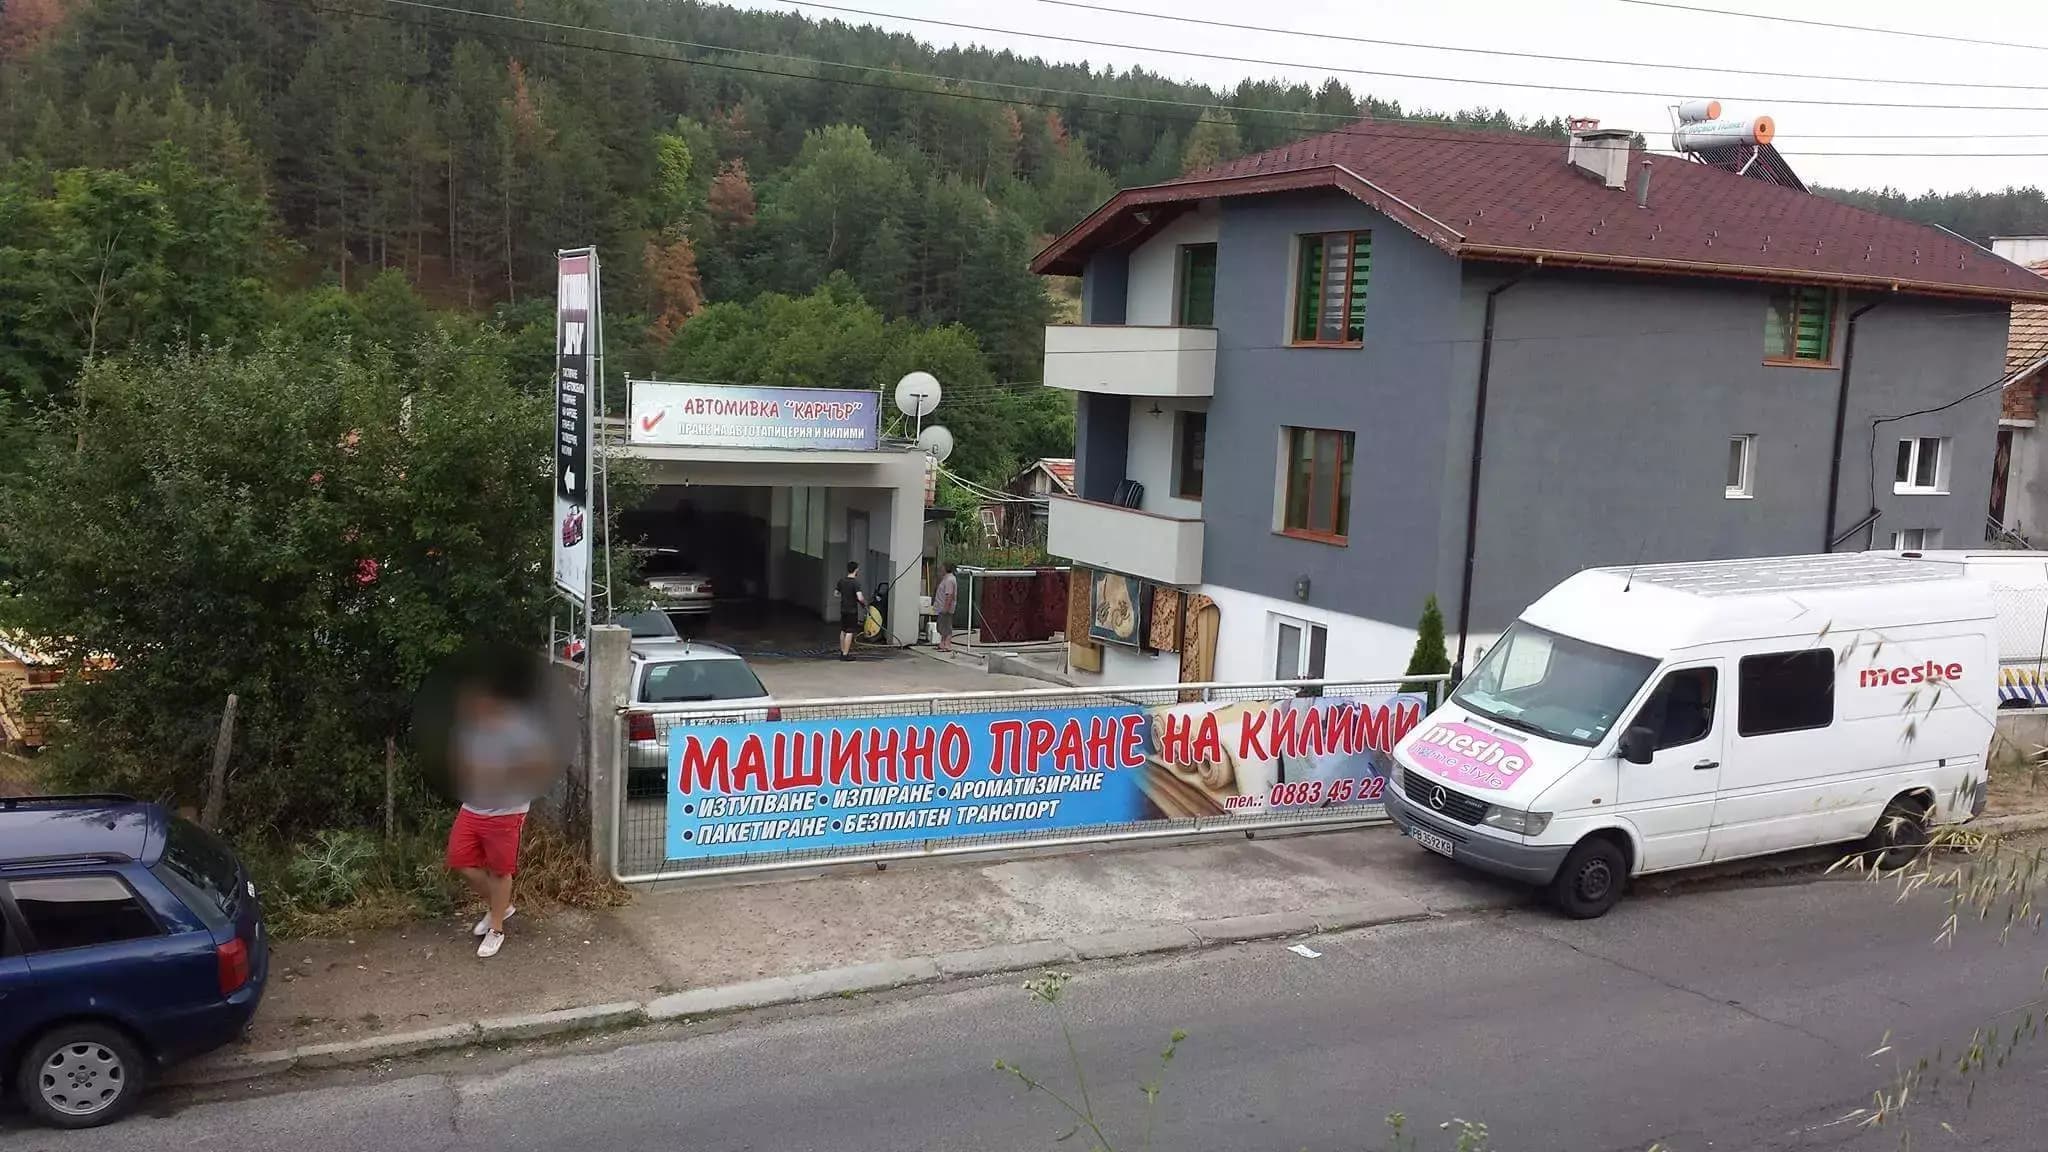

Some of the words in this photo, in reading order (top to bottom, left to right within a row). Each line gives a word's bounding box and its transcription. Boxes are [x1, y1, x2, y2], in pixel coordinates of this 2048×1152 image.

[684, 398, 779, 418] АВТОМИВКА
[678, 422, 712, 435] ПРАНЕ
[713, 424, 729, 436] НА
[729, 425, 812, 439] АВТОТАПИЦЕРИЯ
[814, 427, 821, 438] И
[823, 427, 865, 440] КИЛИМИ
[1860, 660, 1963, 688] meshe
[678, 721, 972, 796] МАШИННО
[988, 713, 1145, 776] ПРАНЕ
[1161, 710, 1222, 766] НА
[1239, 701, 1422, 762] КИЛИМИ
[1421, 726, 1524, 776] meshe
[1460, 764, 1503, 787] style
[697, 790, 817, 818] ИЗТУПВАНЕ
[832, 782, 935, 809] ИЗПИРАНЕ
[949, 772, 1105, 801] АРОМАТИЗИРАНЕ
[1269, 781, 1322, 807] 0883
[1327, 778, 1353, 802] 45
[1358, 776, 1385, 801] 22
[696, 818, 827, 845] ПАКЕТИРАНЕ
[844, 806, 951, 834] БЕЗПЛАТЕН
[956, 799, 1060, 826] ТРАНСПОРТ
